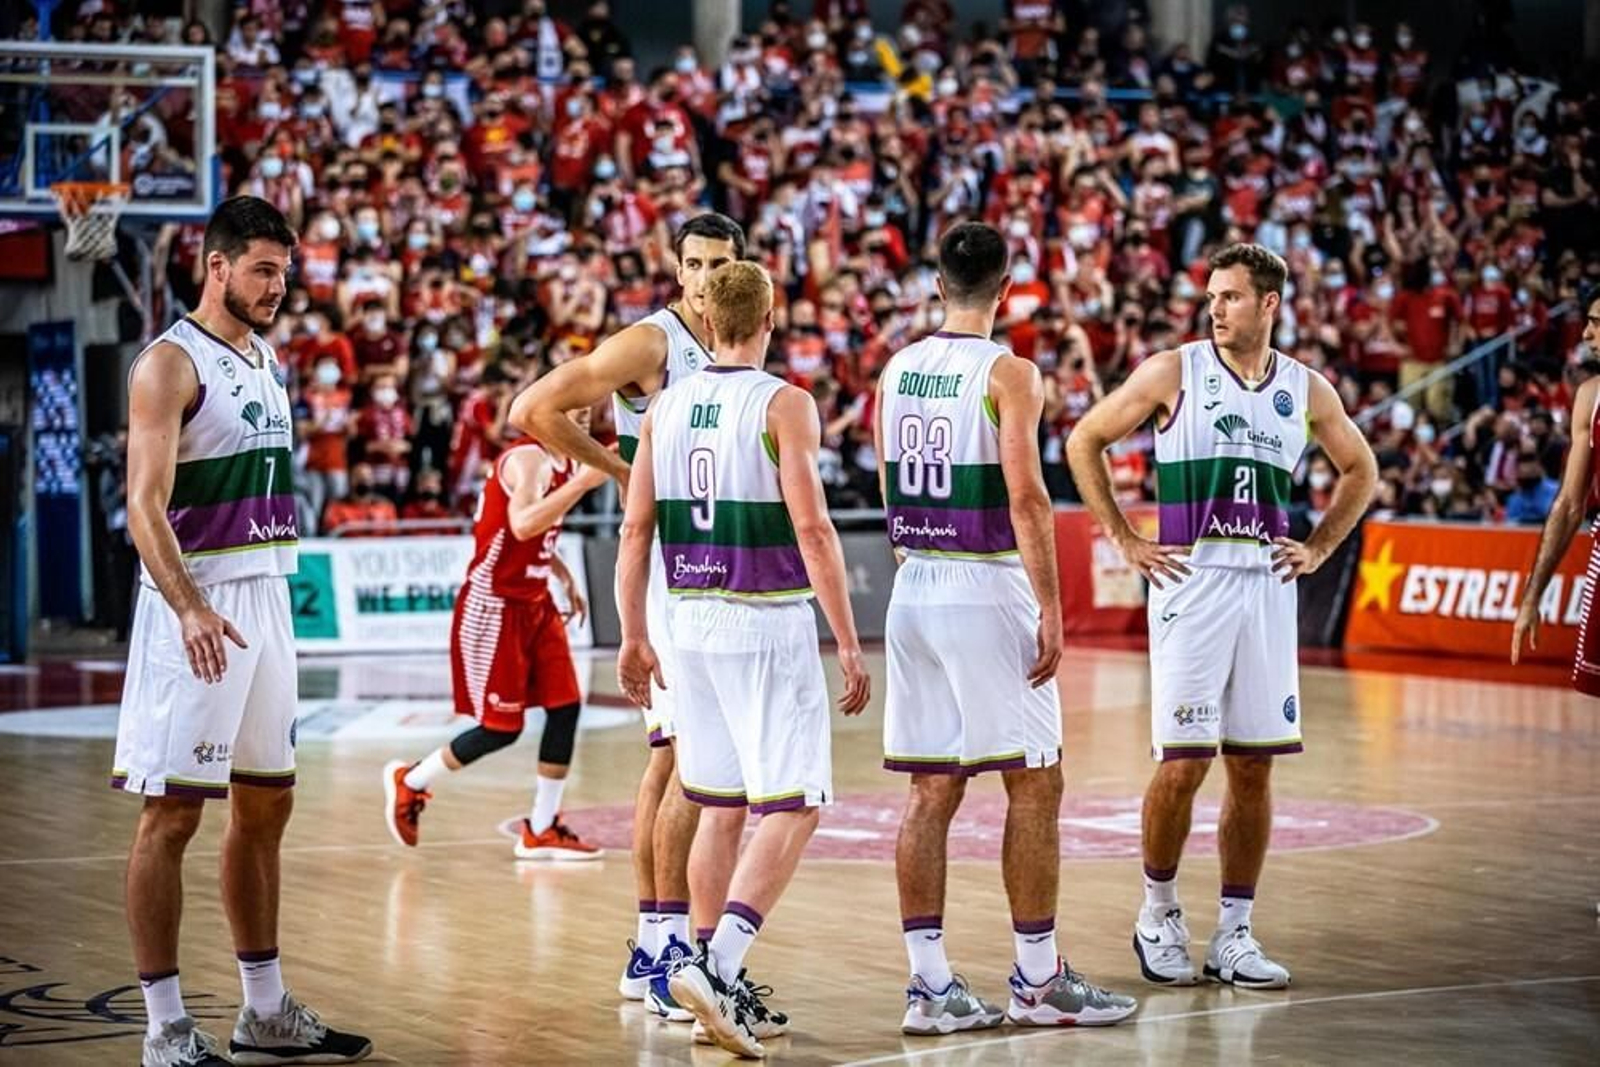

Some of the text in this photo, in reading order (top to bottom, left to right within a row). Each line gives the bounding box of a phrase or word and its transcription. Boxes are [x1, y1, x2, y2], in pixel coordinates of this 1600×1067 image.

[898, 414, 952, 498] 83
[1247, 429, 1282, 449] Unicaja
[265, 456, 275, 500] 7
[688, 447, 716, 532] 9
[1233, 465, 1257, 505] 21
[350, 547, 458, 578] YOU SHIP
[355, 583, 398, 614] WE
[1400, 564, 1564, 624] ESTRELA
